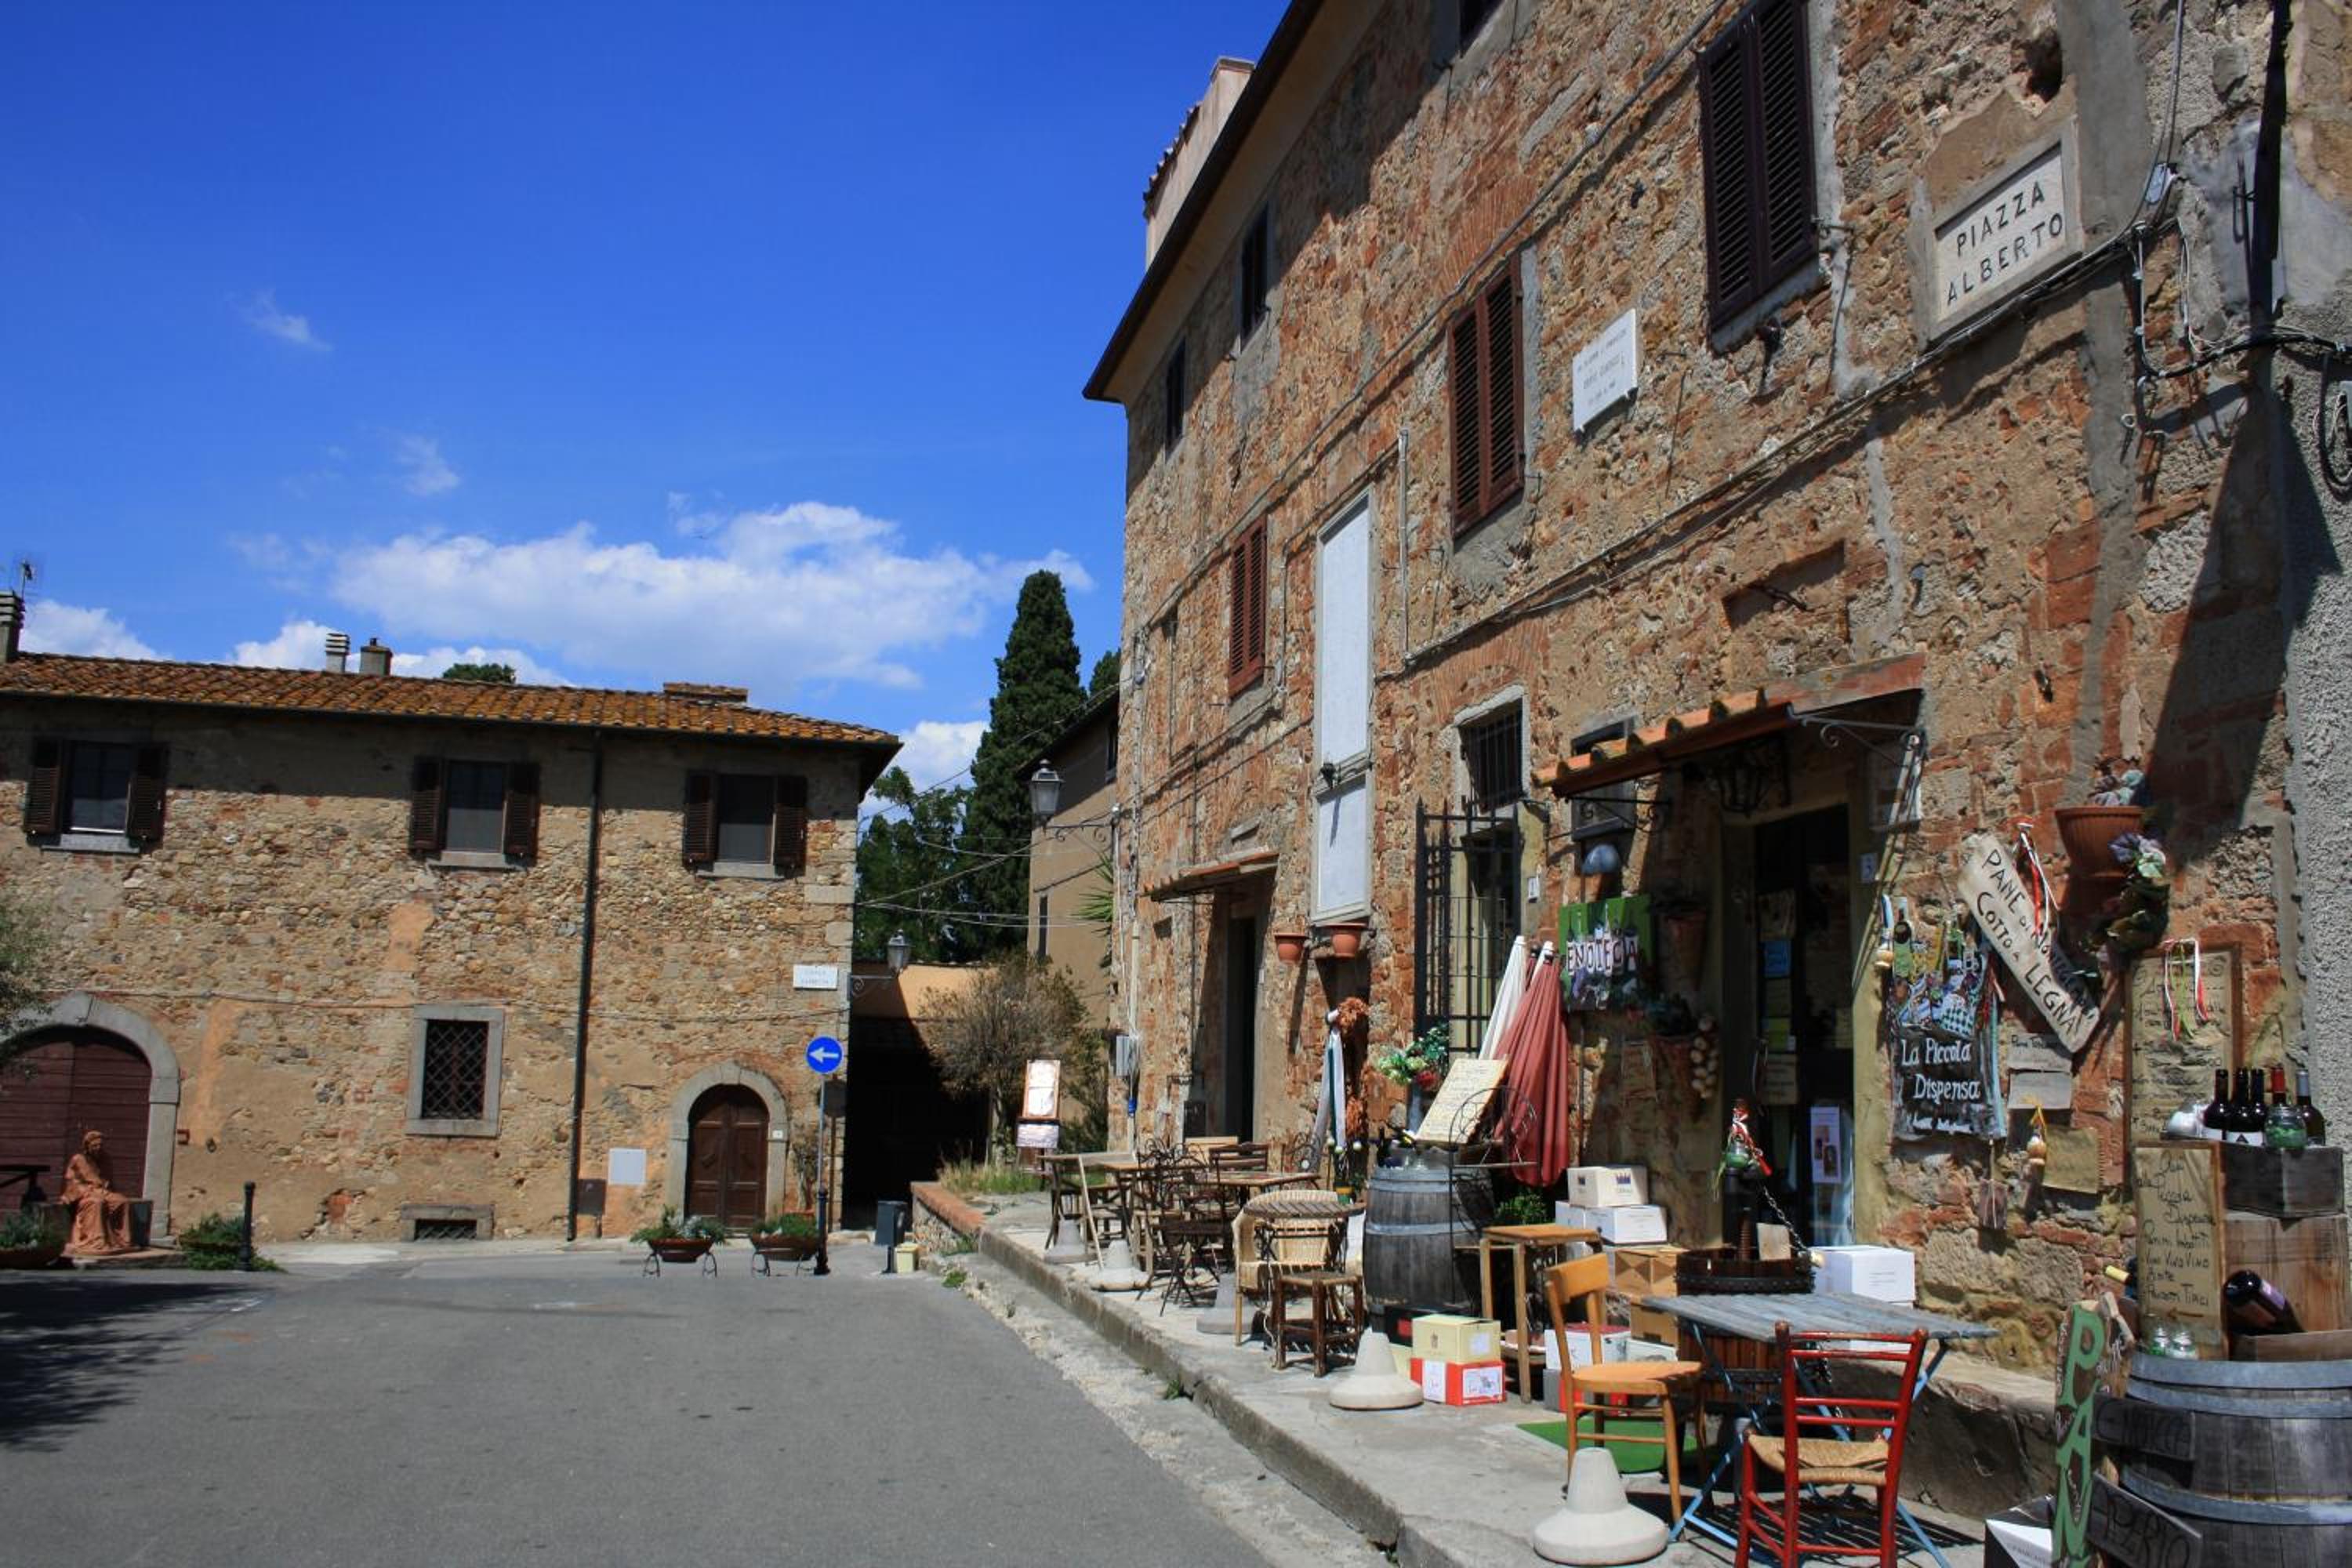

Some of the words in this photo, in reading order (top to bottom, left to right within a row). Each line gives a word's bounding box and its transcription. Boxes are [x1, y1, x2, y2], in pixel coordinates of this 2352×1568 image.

[1956, 181, 2045, 258] PIAZZA
[1947, 212, 2063, 306] ALBERTO
[1982, 849, 2026, 915] PANE
[1568, 938, 1638, 972] ENOTECA
[2025, 964, 2078, 1035] LEGNA
[1900, 1039, 1920, 1066] La
[1926, 1037, 1972, 1065] Piccola
[1913, 1073, 1981, 1105] Dispensa
[2053, 1303, 2106, 1568] PAN
